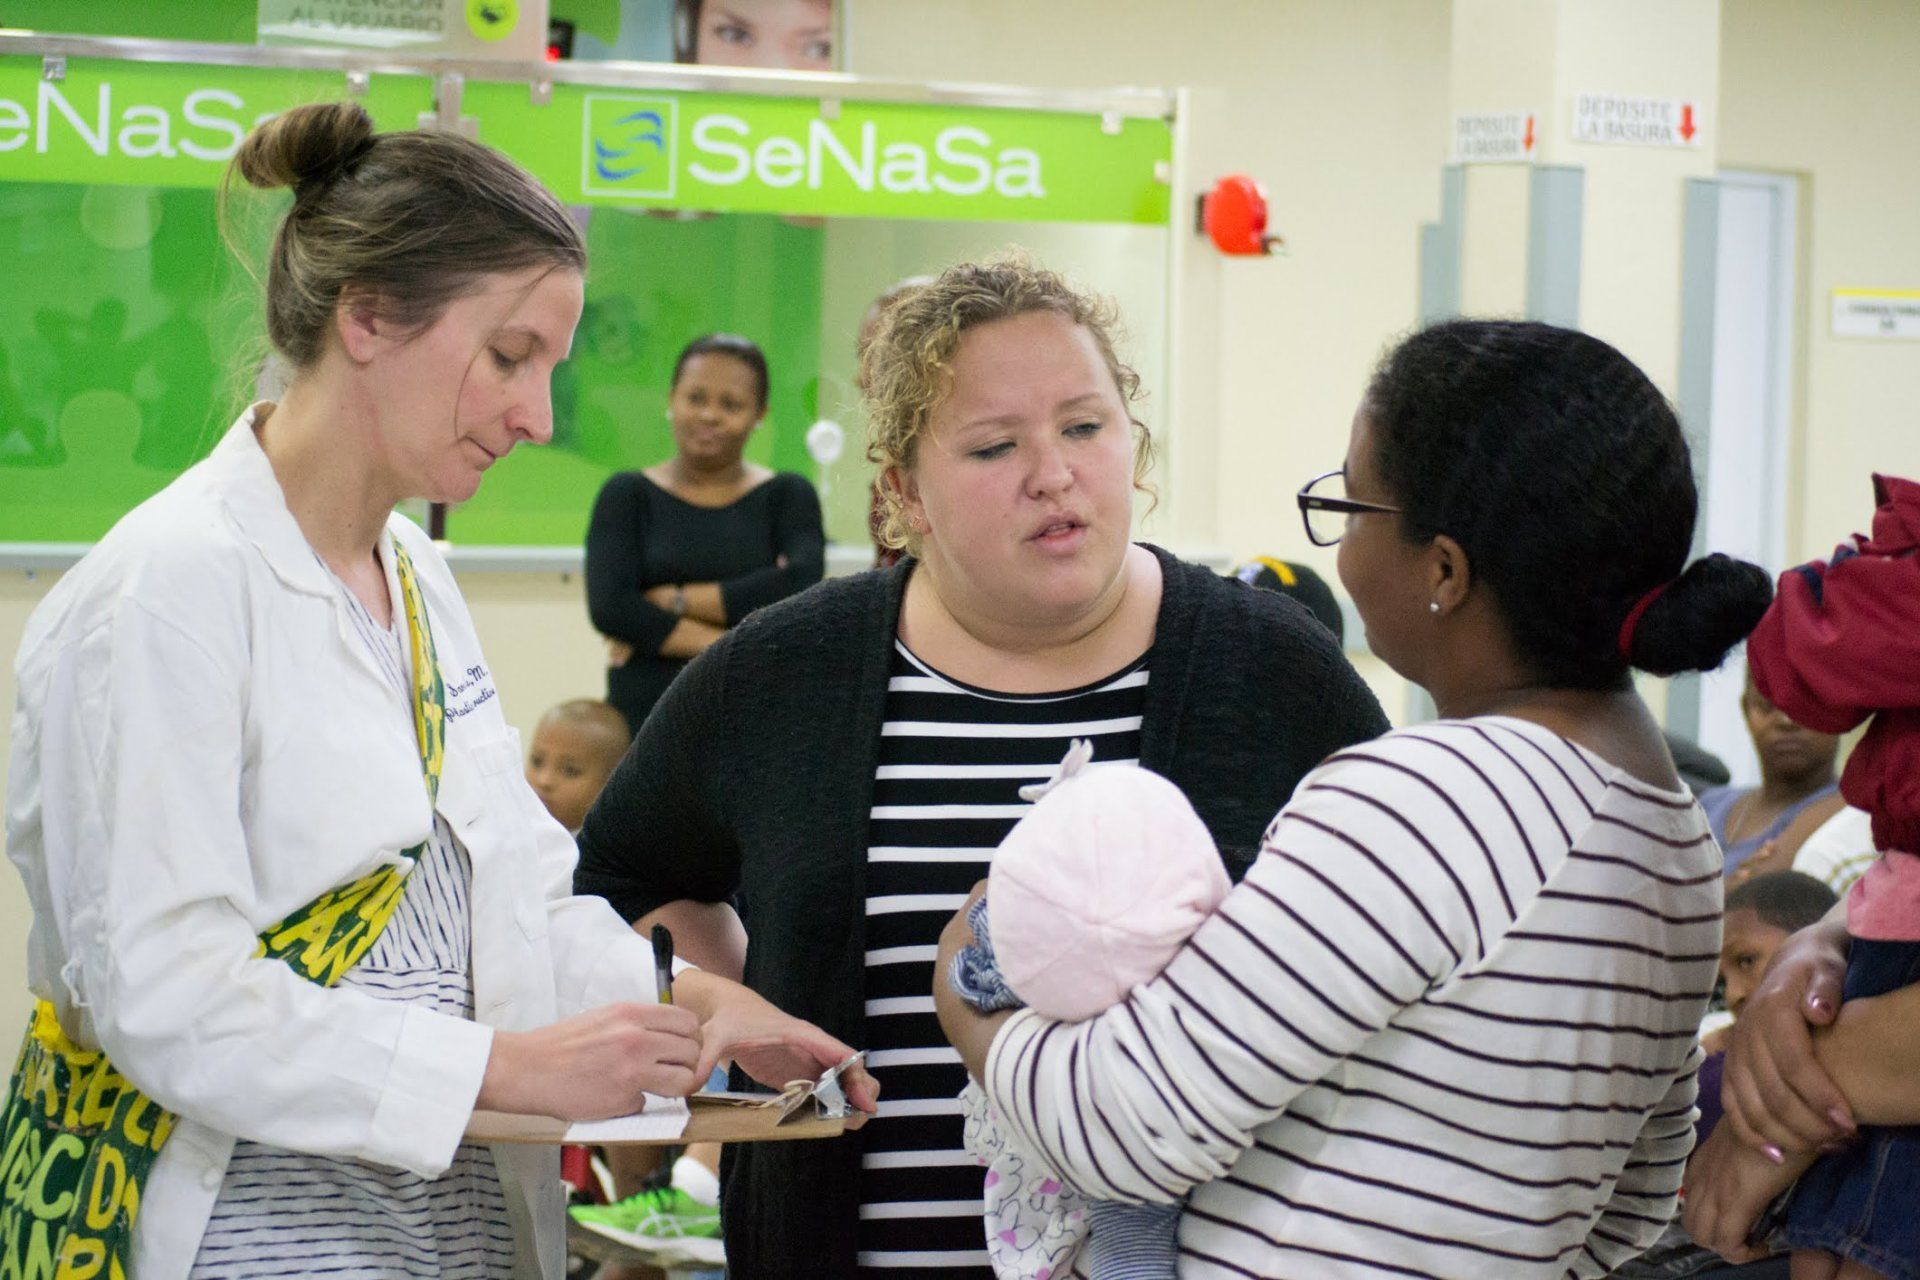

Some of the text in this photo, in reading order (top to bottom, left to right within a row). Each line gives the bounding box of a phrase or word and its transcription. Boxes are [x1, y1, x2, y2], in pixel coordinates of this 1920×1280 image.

[0, 81, 277, 161] eNaS
[1578, 93, 1672, 120] DEPOSITE
[688, 114, 1046, 199] SeNaSa
